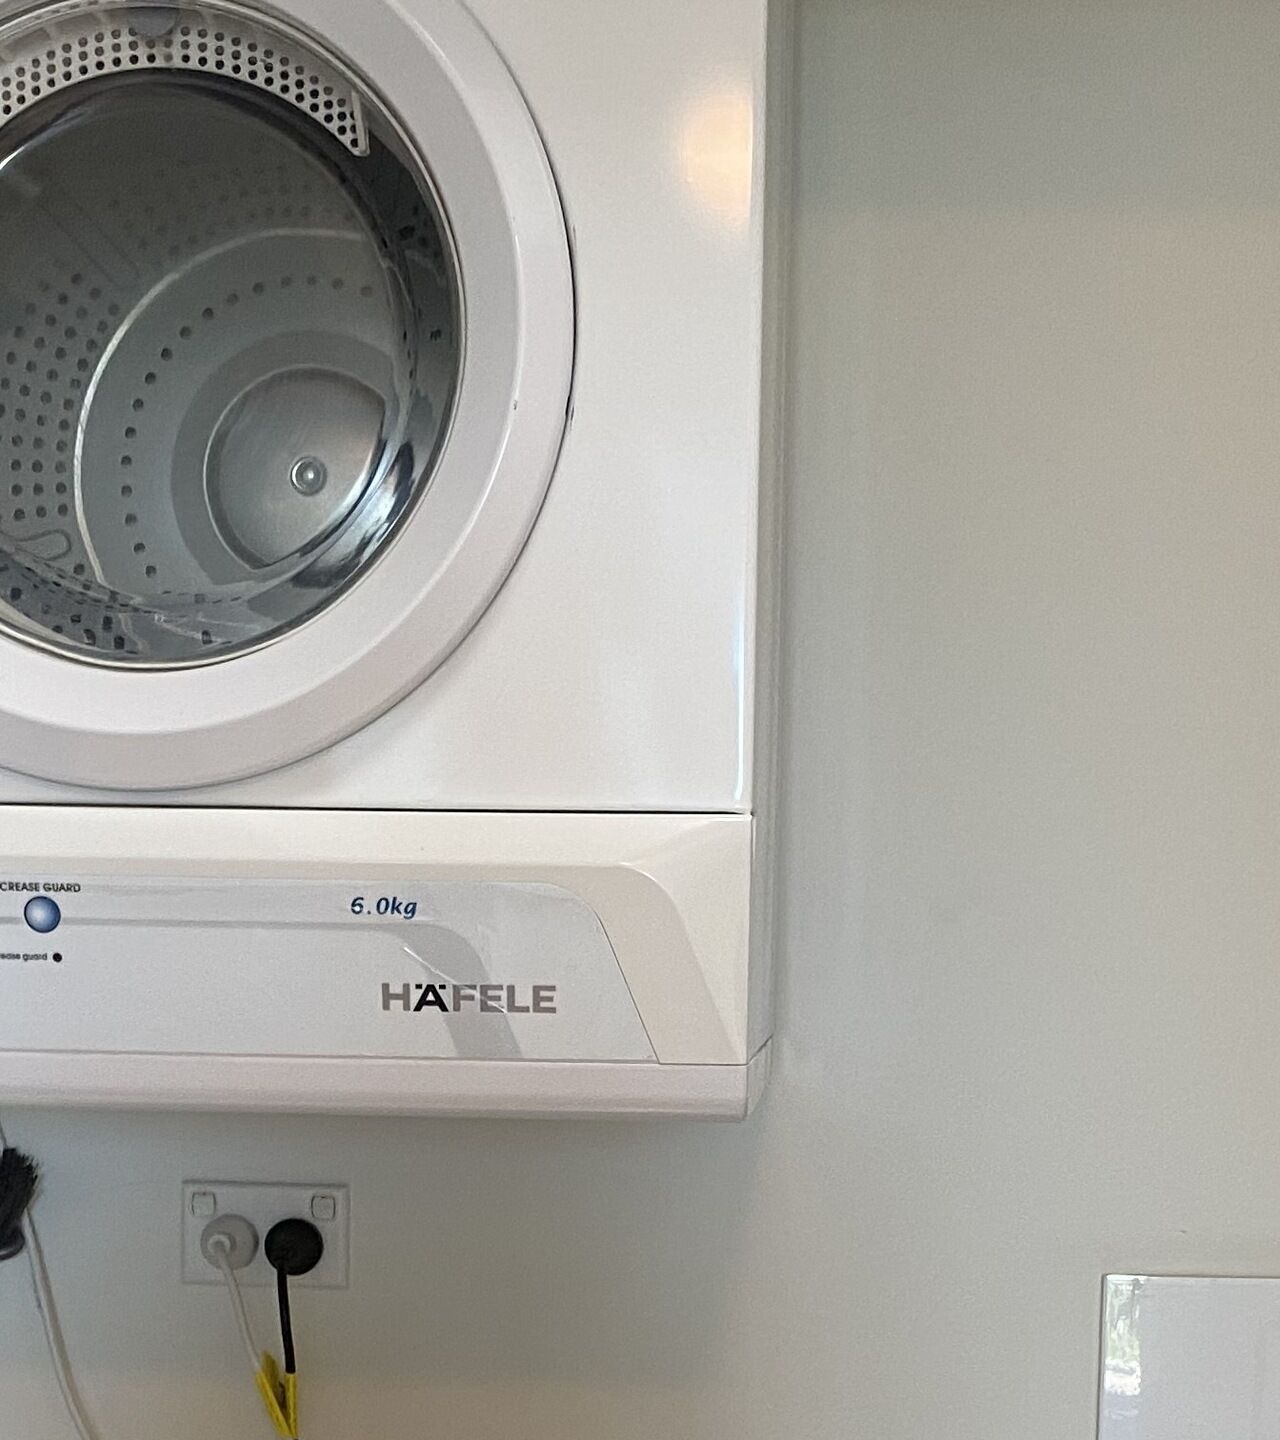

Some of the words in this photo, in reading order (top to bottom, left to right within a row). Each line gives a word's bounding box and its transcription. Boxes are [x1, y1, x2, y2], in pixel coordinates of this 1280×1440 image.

[0, 882, 41, 892] CREASE
[42, 882, 81, 893] GUARD
[350, 896, 418, 919] 6.0kg
[22, 952, 48, 962] guard
[381, 983, 557, 1013] HÄFELE
